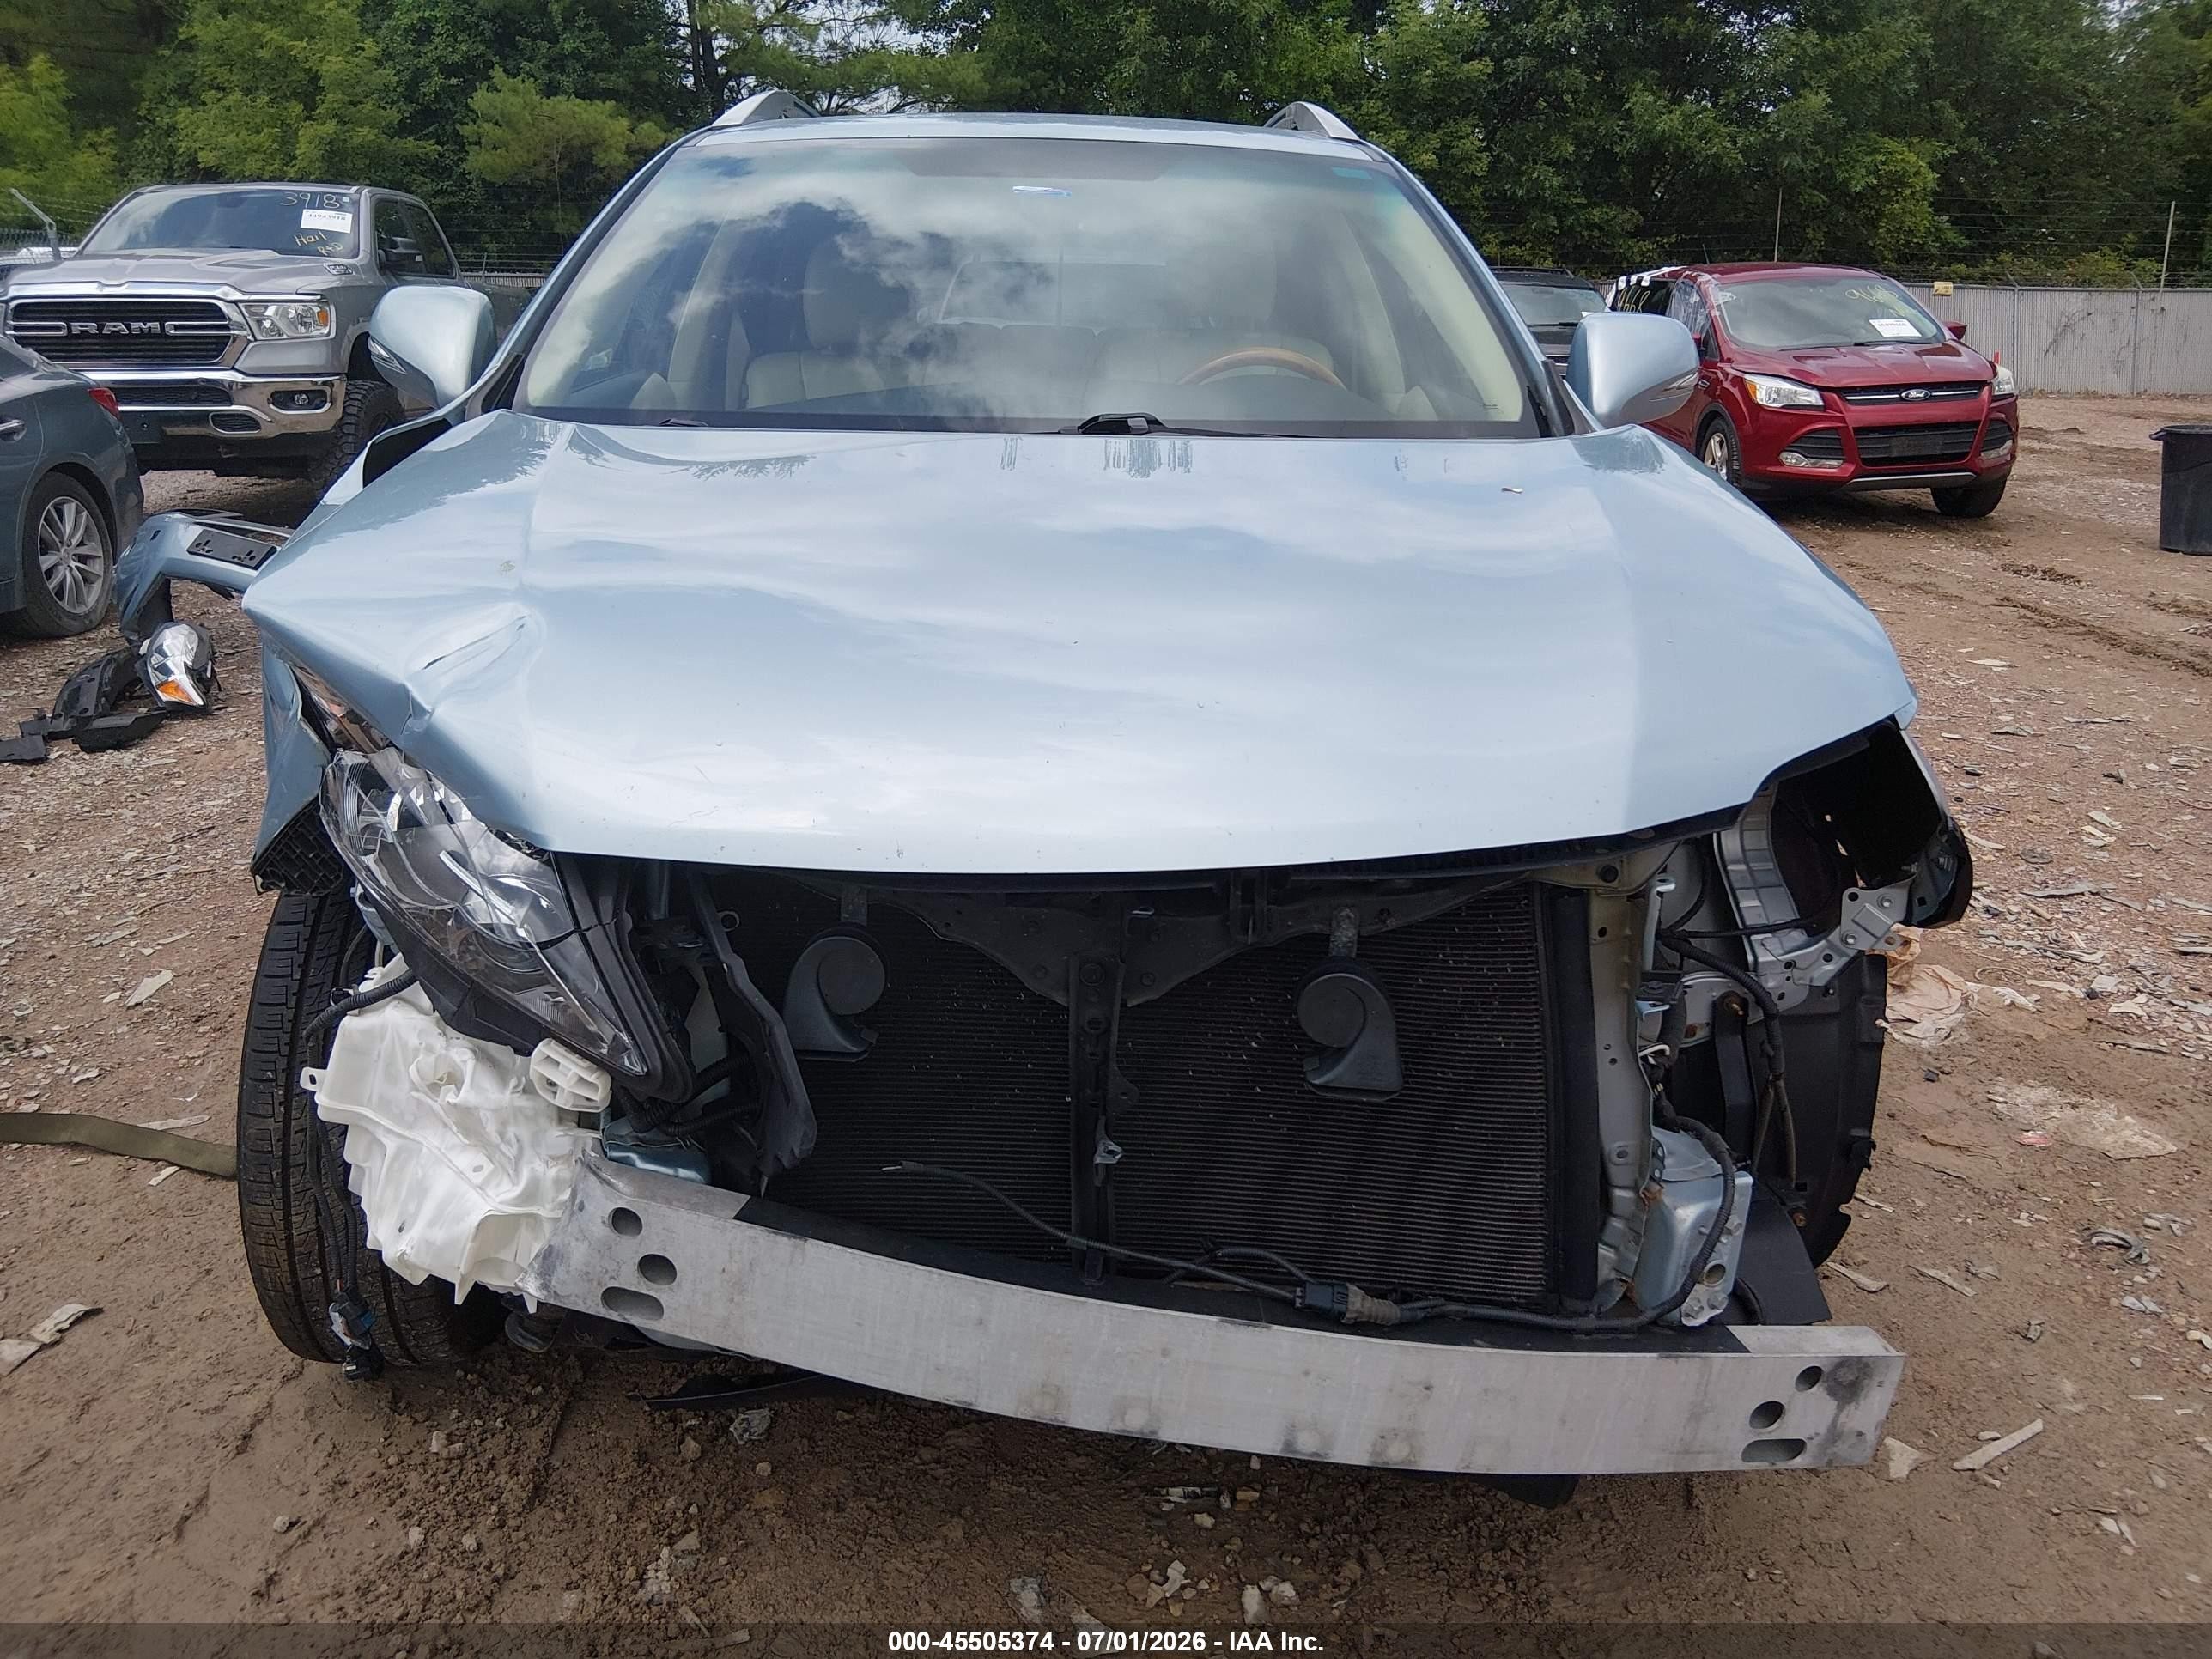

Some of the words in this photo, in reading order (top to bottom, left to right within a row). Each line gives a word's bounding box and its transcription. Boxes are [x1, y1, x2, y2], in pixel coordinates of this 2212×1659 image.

[280, 191, 340, 209] 3918
[294, 230, 327, 246] Hail
[70, 322, 161, 334] RAM
